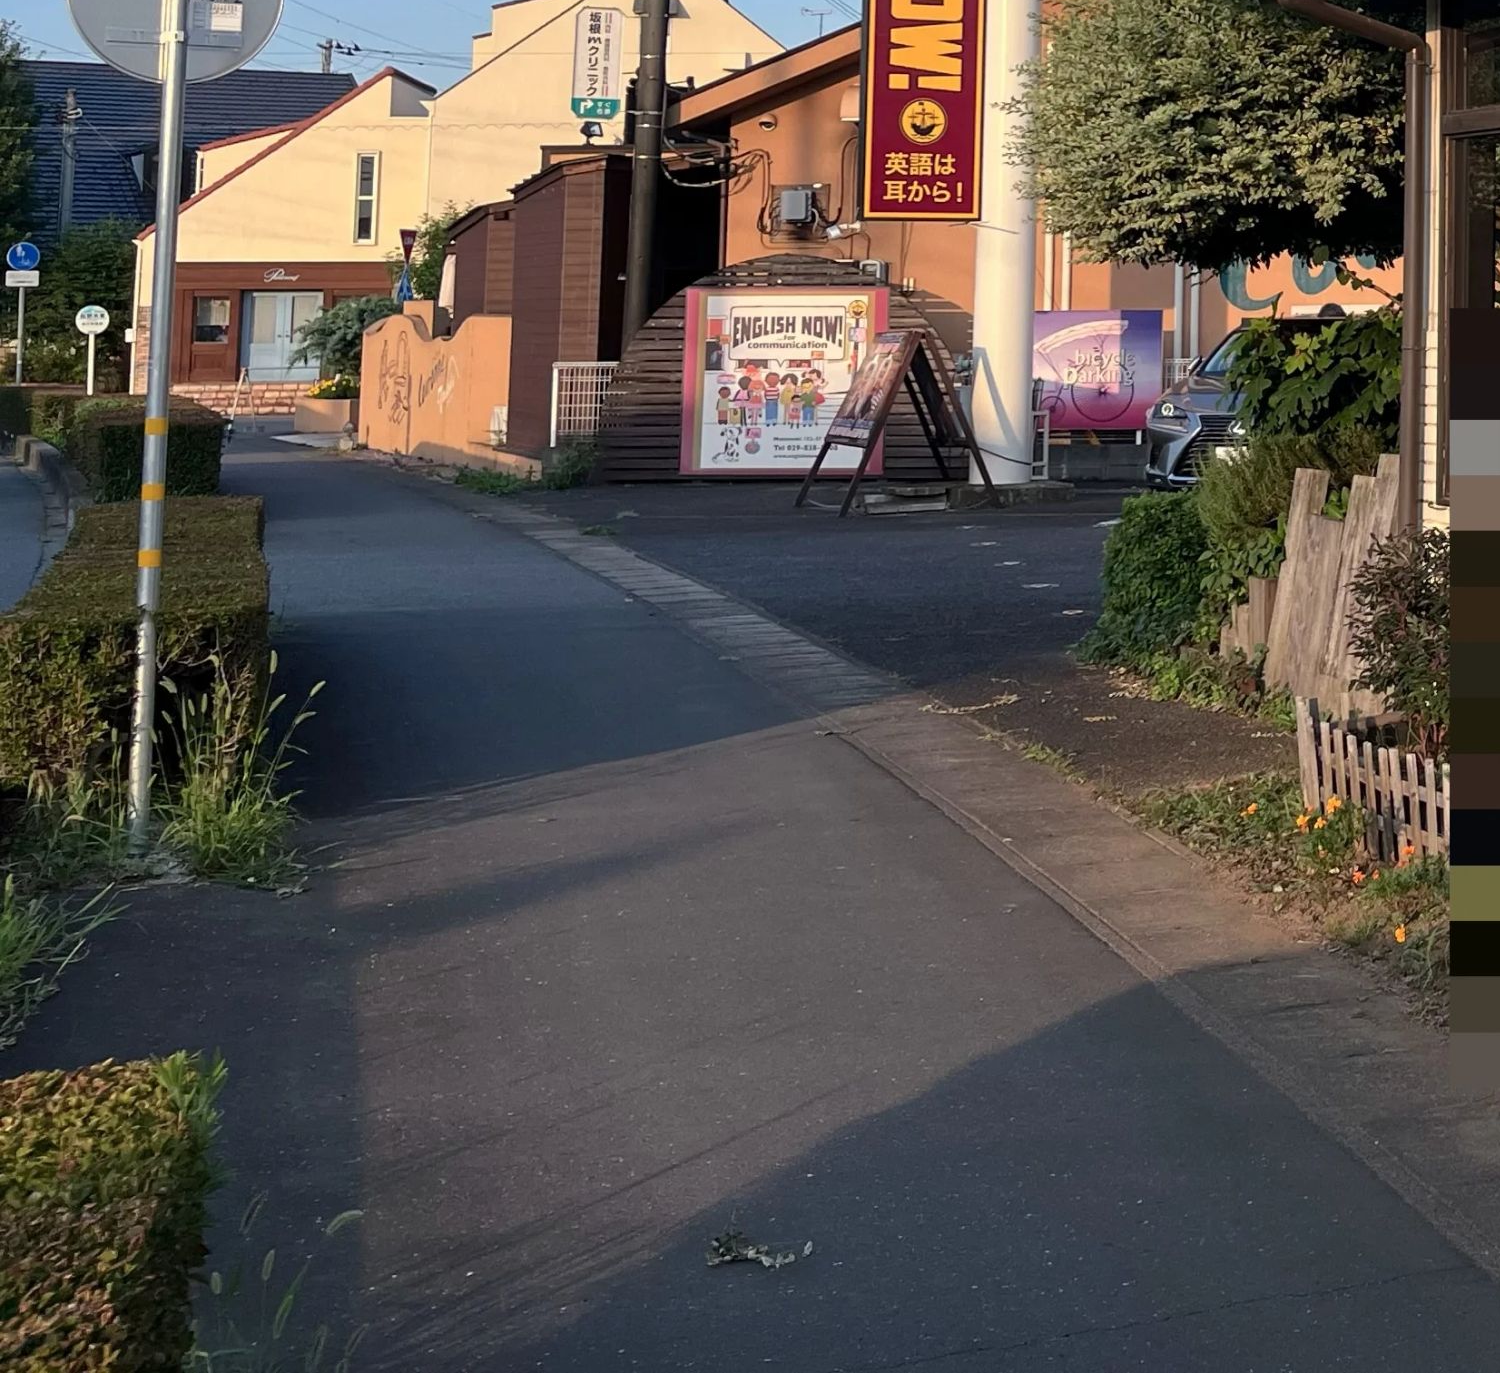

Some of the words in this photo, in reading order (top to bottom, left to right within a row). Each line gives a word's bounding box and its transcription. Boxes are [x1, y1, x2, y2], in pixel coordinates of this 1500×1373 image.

[884, 152, 956, 176] 英語は
[732, 316, 796, 348] ENGLISH
[801, 315, 843, 348] NOW!
[747, 341, 828, 349] communication
[1075, 348, 1136, 370] bicycle
